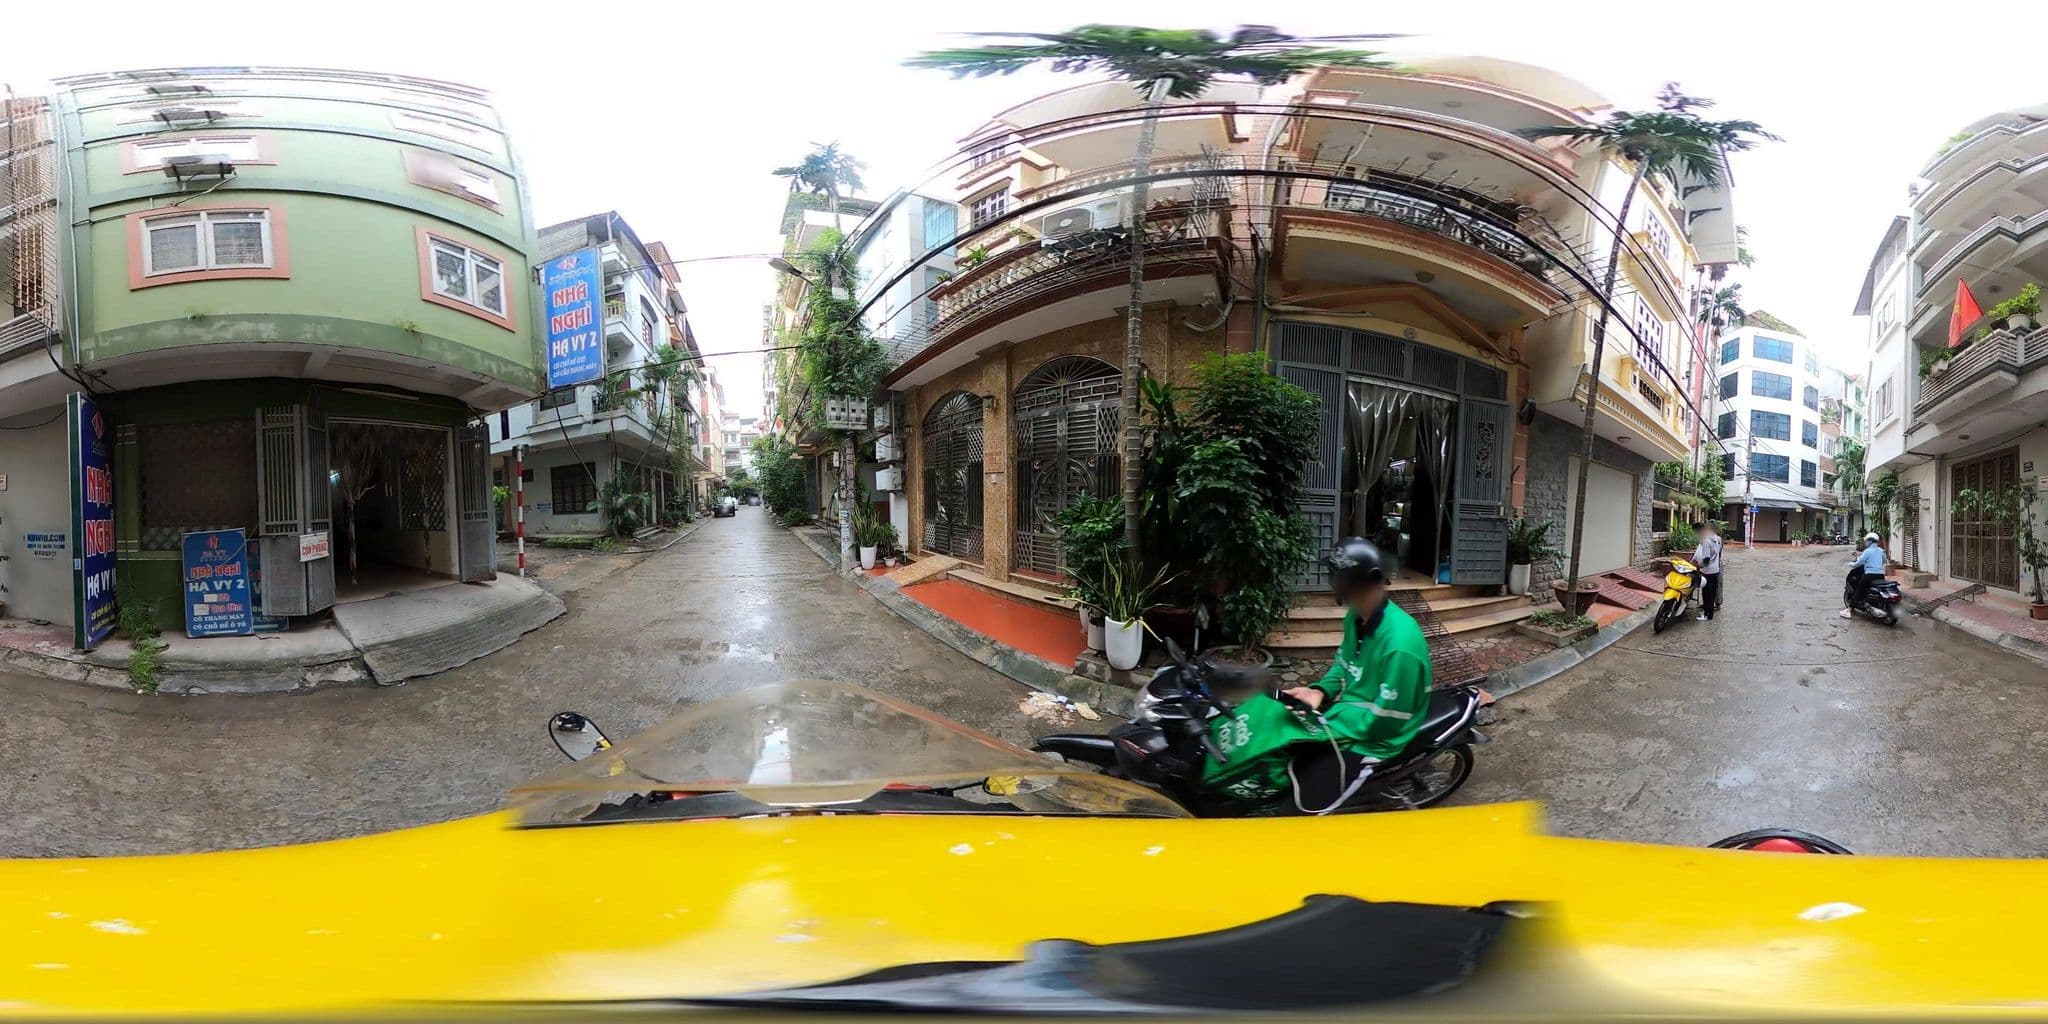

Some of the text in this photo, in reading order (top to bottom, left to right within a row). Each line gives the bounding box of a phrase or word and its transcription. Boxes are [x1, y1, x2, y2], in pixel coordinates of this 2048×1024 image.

[553, 280, 588, 308] NHÀ
[552, 301, 592, 335] NGHỈ
[553, 331, 597, 358] HẠ VY 2
[86, 464, 113, 508] NHÀ
[87, 573, 100, 600] HẠ
[101, 569, 111, 592] VY
[191, 564, 213, 578] NHÀ
[213, 580, 233, 591] VY
[237, 579, 245, 589] 2
